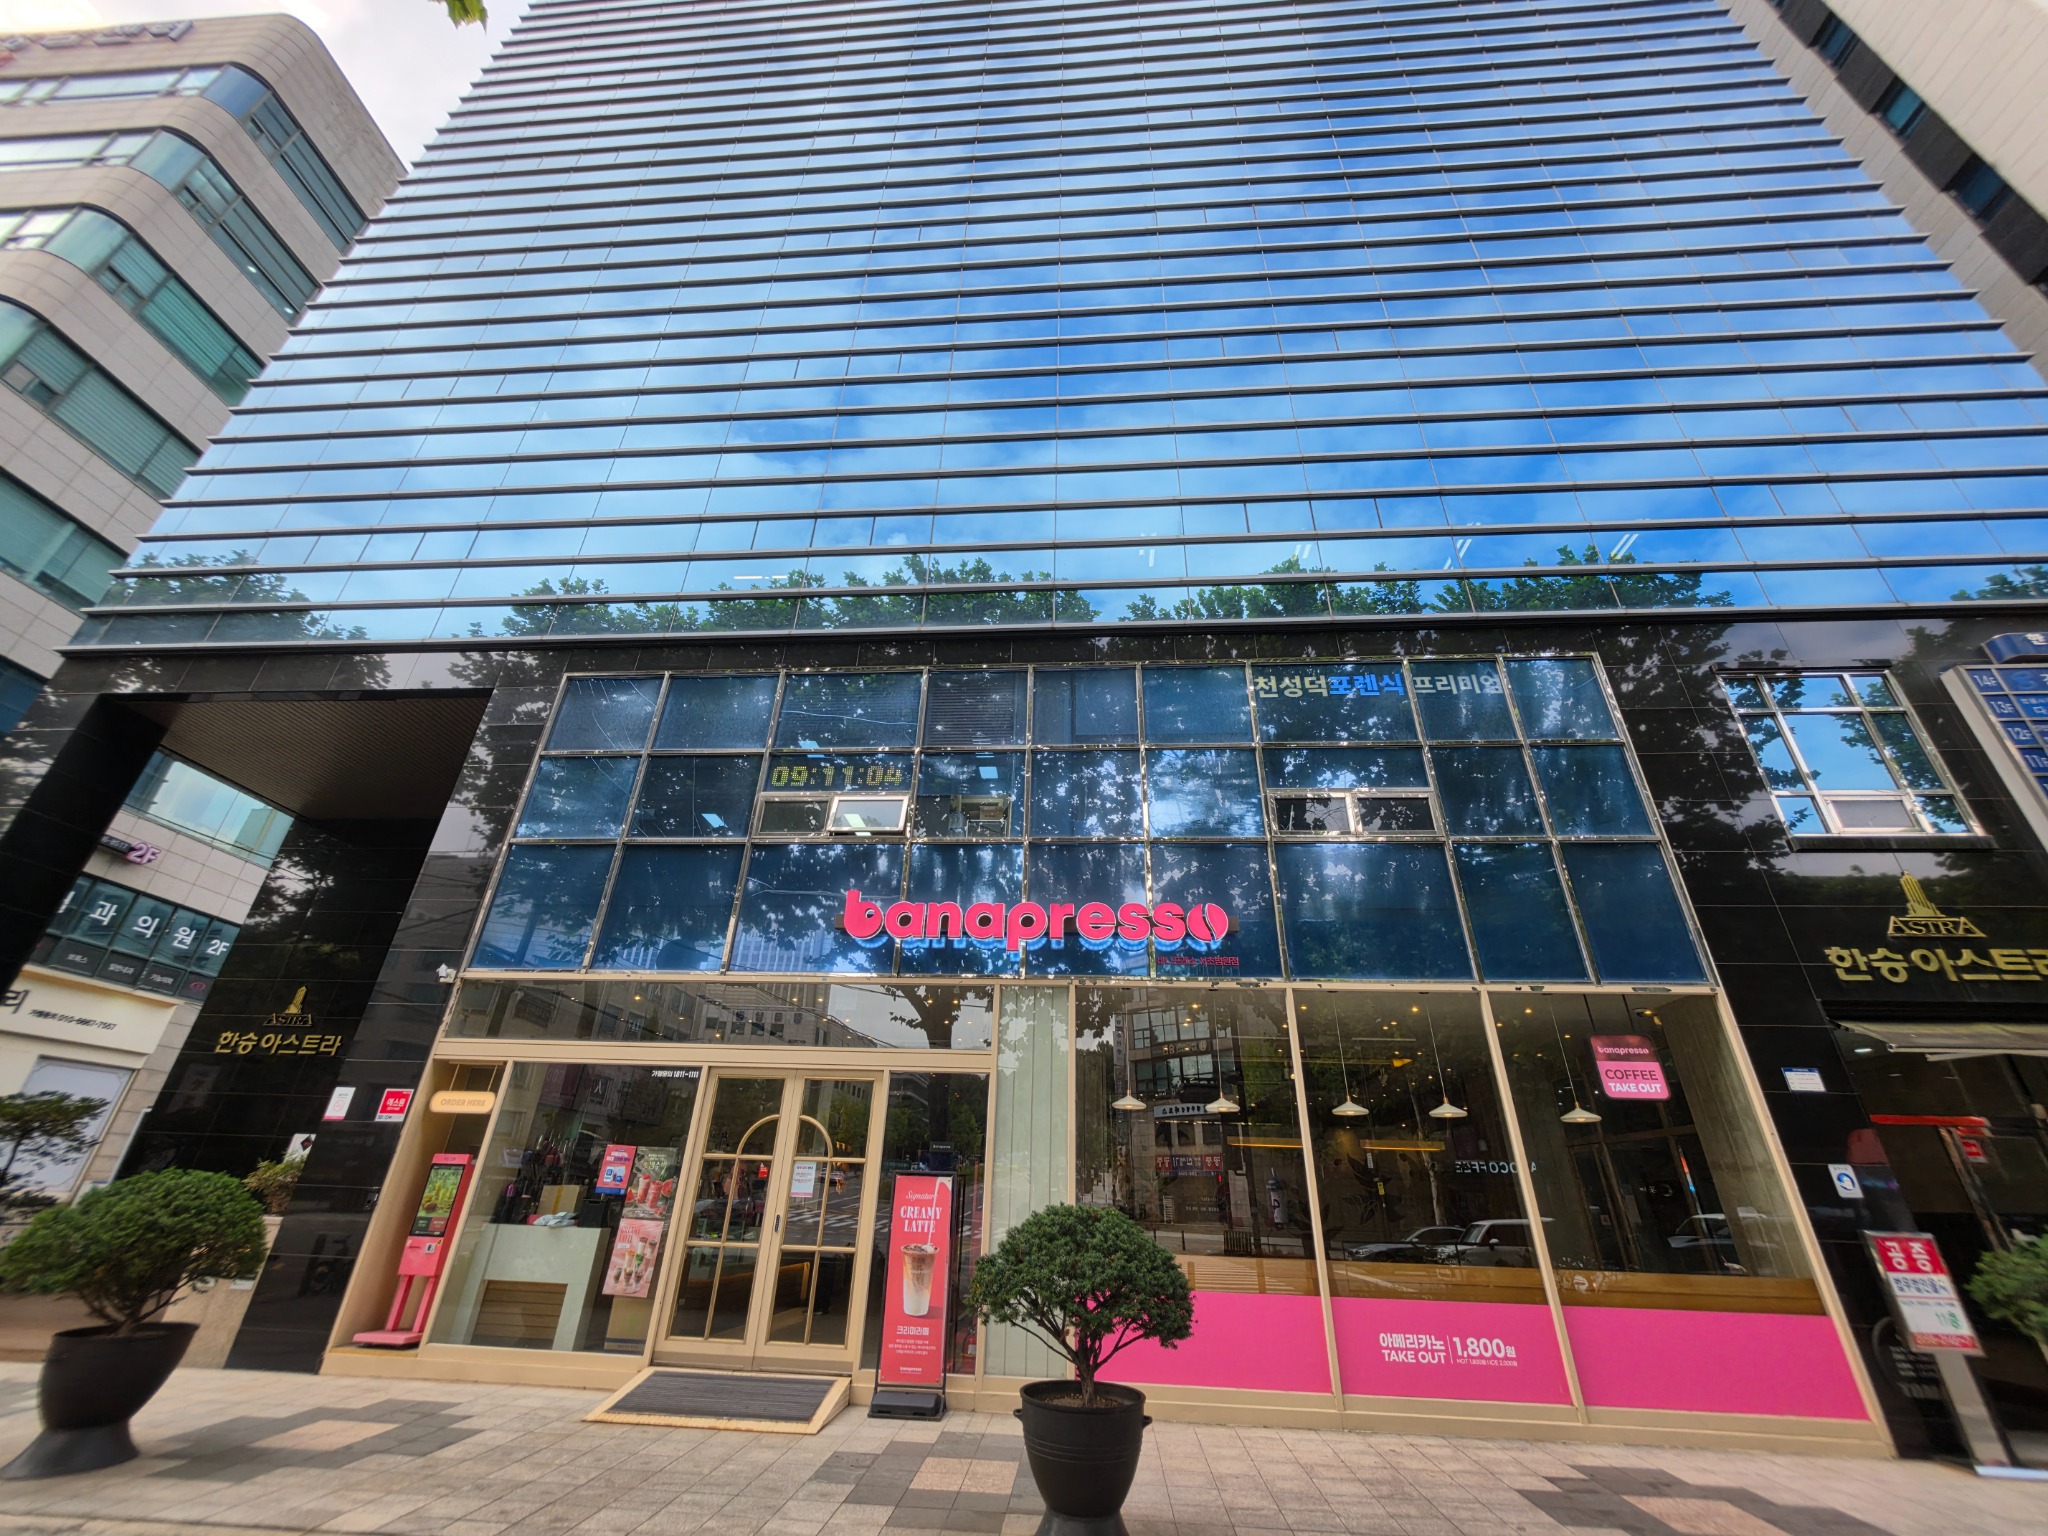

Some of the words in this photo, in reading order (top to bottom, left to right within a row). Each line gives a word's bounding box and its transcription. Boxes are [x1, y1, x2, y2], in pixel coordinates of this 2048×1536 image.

[1413, 674, 1504, 695] 프리미엄
[1973, 674, 1997, 686] 14F
[1990, 701, 2015, 713] 13F
[2007, 727, 2032, 739] 12F
[771, 766, 902, 786] 09:11:04
[127, 843, 161, 864] 2F
[844, 890, 1229, 951] banapresso
[1887, 915, 1988, 938] ASTRA
[206, 939, 230, 956] 2F
[264, 1012, 312, 1027] ASTRA
[1597, 1046, 1649, 1055] banapresso
[1605, 1069, 1659, 1080] COFFEE
[1608, 1083, 1638, 1092] TAKE
[1638, 1083, 1661, 1093] OUT
[466, 1099, 486, 1107] HERE
[900, 1206, 942, 1220] CREAMY
[903, 1220, 936, 1233] LATTE
[1884, 1241, 1933, 1272] 공증
[896, 1325, 929, 1336] 크리미라떼
[1379, 1333, 1446, 1350] 아메리카노
[1453, 1337, 1517, 1358] 1,800원
[1382, 1350, 1416, 1362] TAKE
[1418, 1352, 1446, 1364] OUT
